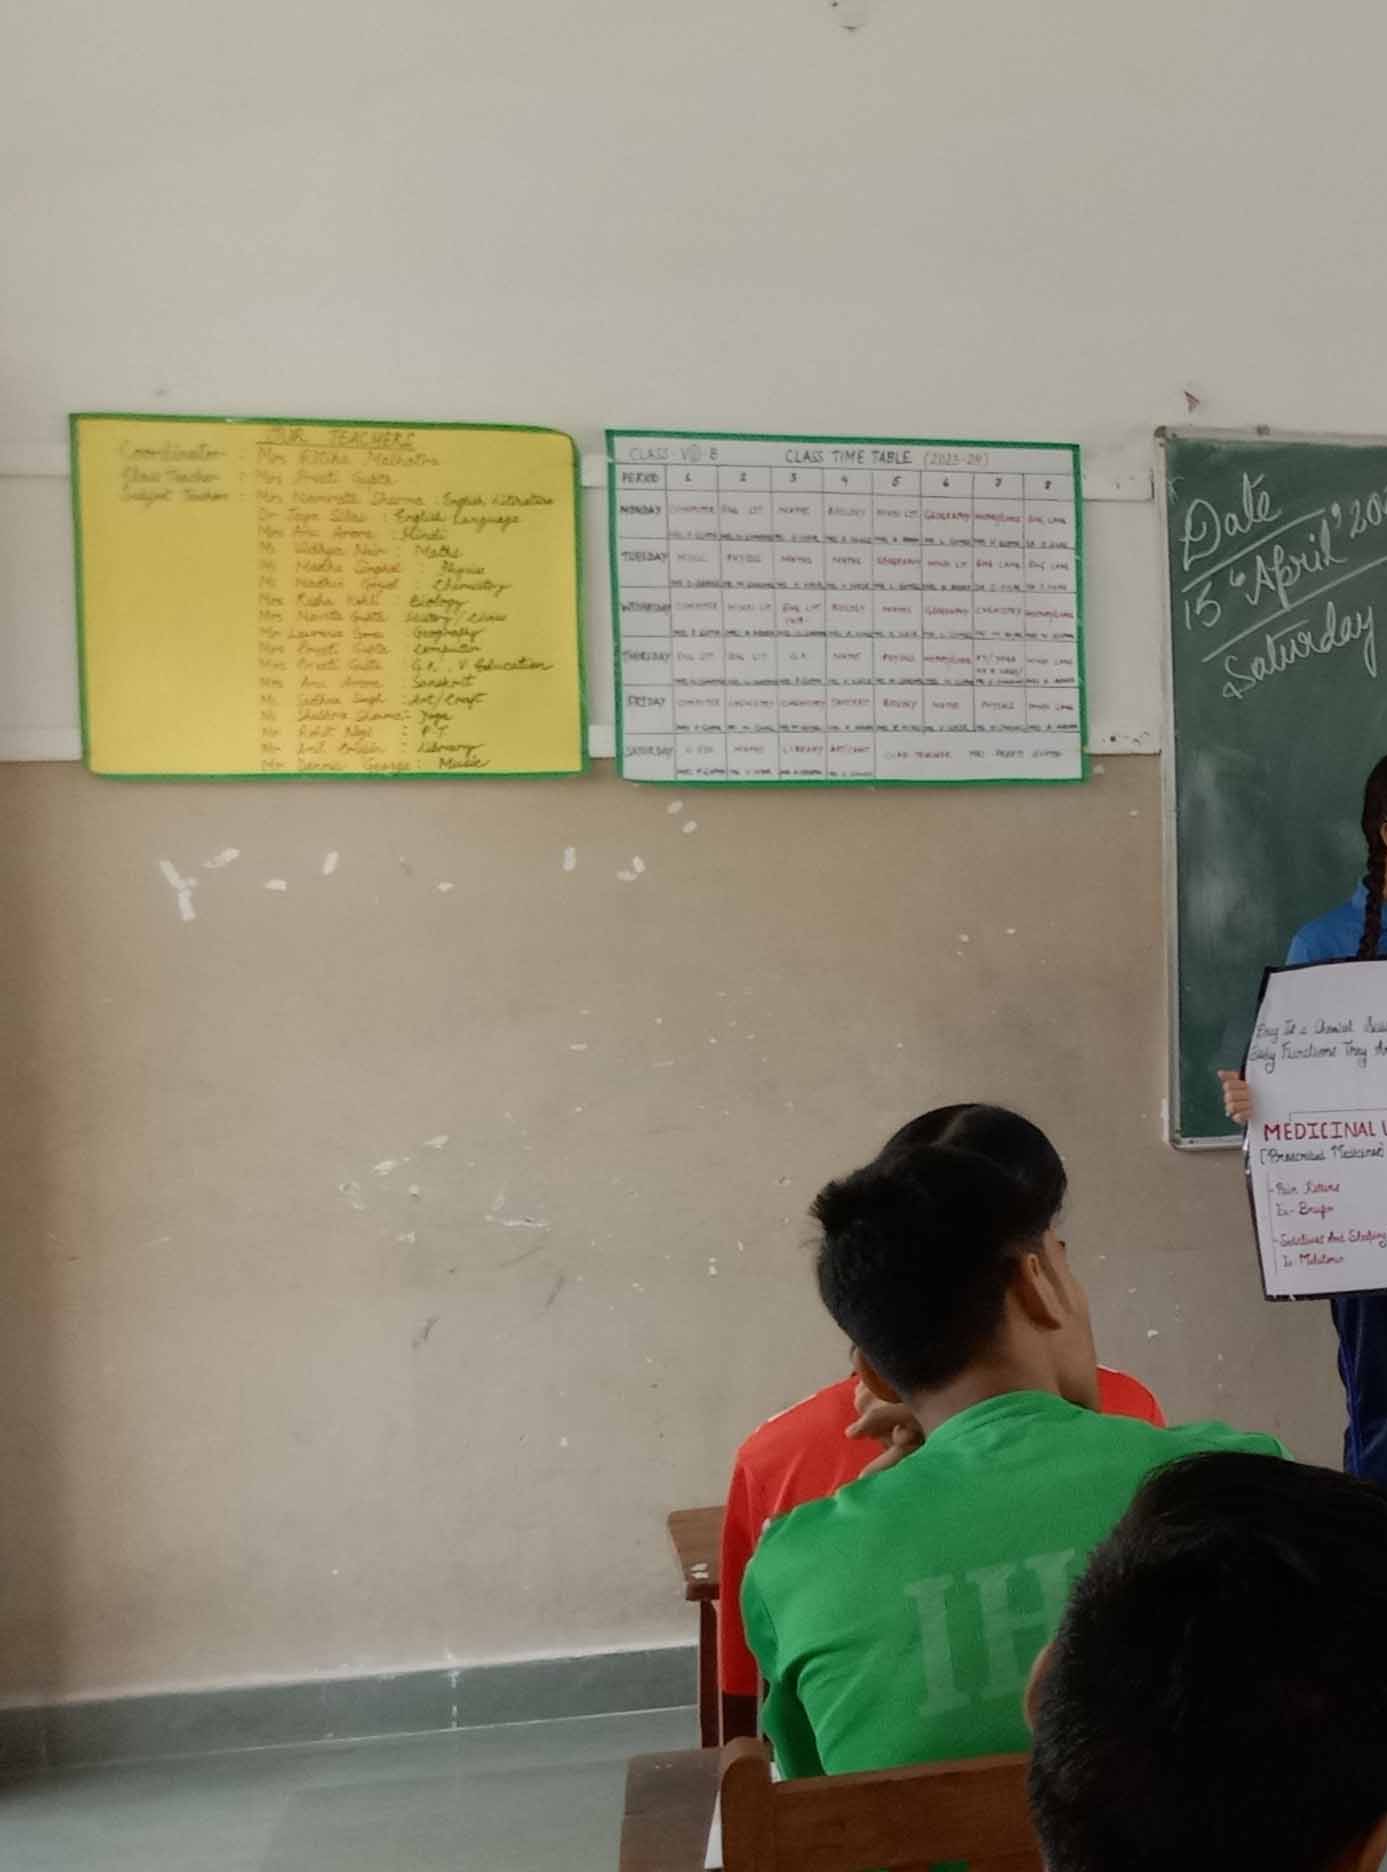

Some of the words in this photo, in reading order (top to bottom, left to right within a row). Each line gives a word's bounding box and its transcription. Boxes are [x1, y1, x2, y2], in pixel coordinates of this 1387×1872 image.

[784, 449, 825, 464] CLASS
[831, 449, 865, 464] TIME
[872, 450, 913, 465] TABLE
[1178, 471, 1283, 572] Date
[1184, 581, 1222, 631] 15
[1222, 600, 1377, 700] Saturday
[1263, 1120, 1377, 1142] MEDICINAL
